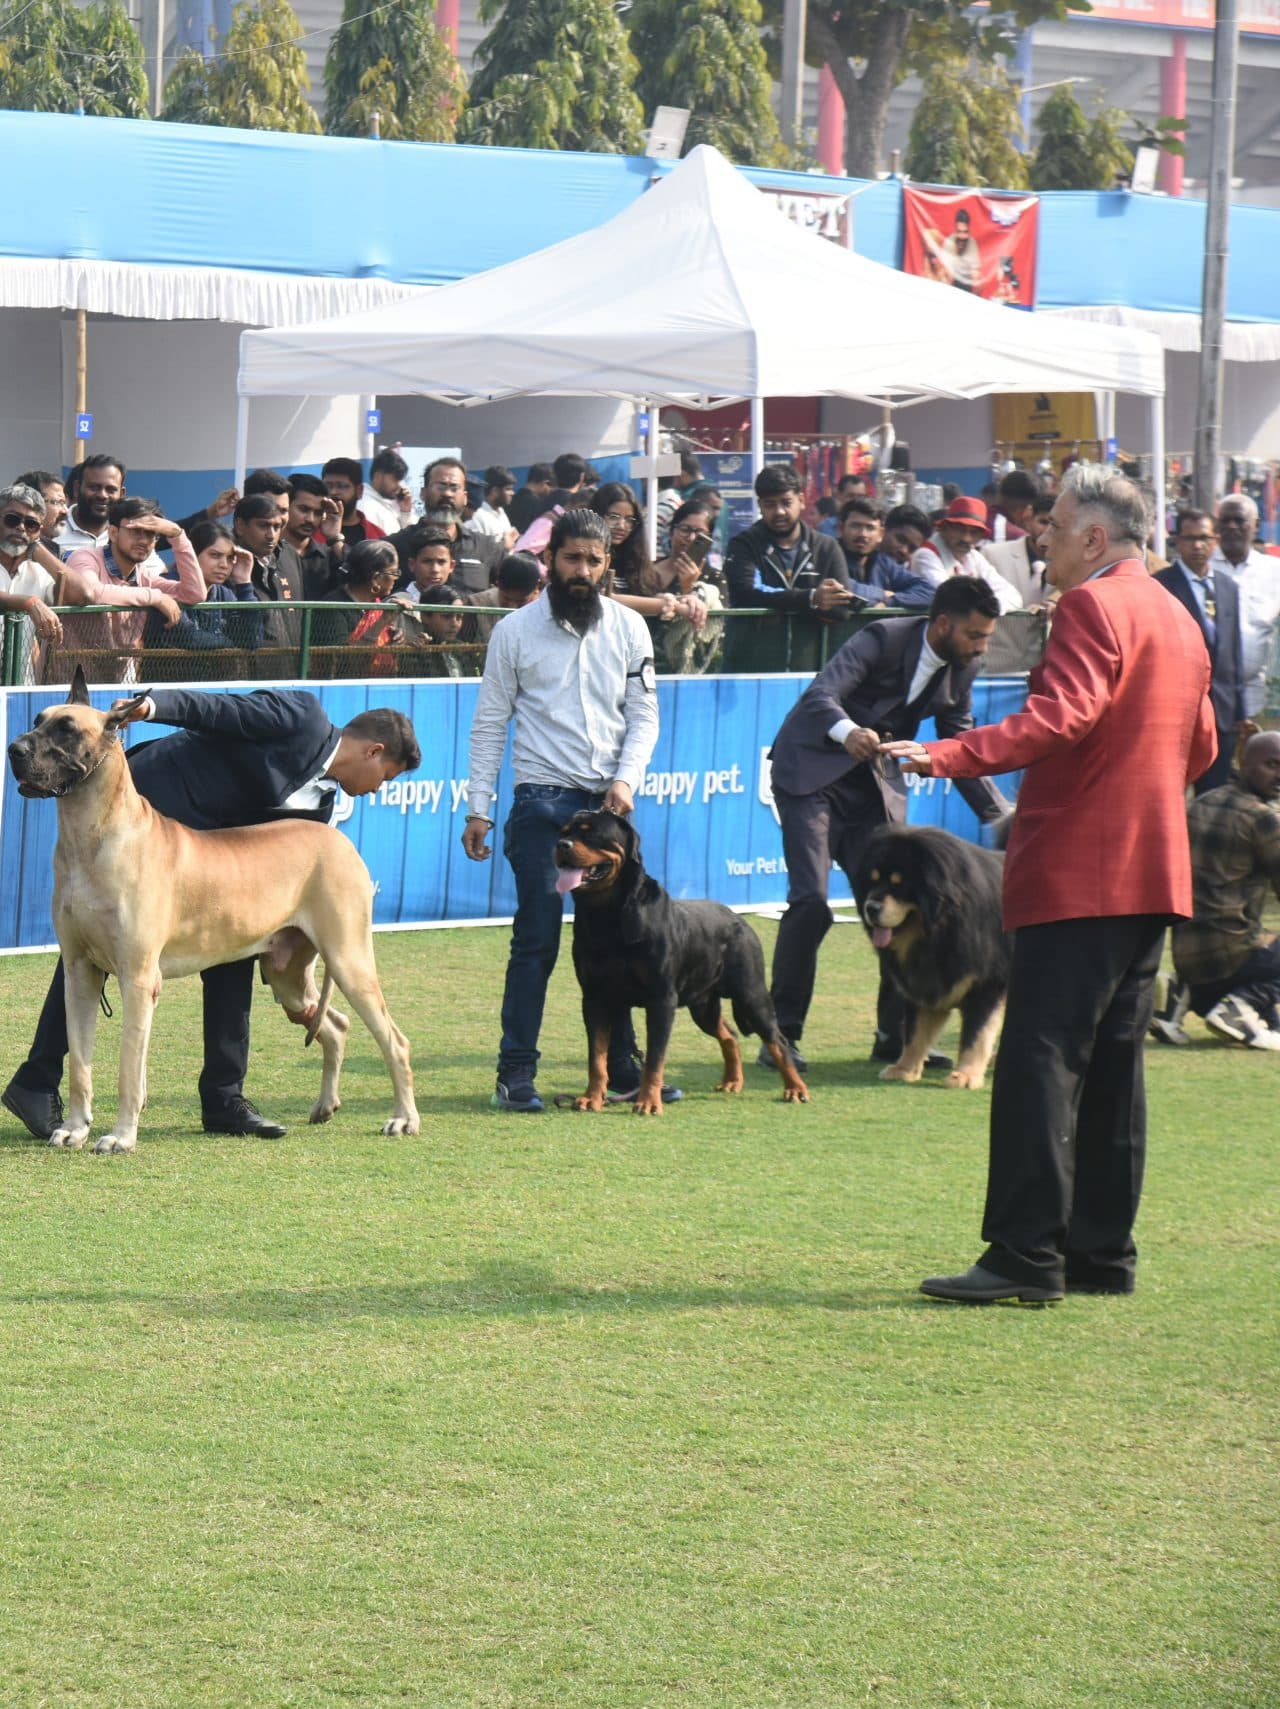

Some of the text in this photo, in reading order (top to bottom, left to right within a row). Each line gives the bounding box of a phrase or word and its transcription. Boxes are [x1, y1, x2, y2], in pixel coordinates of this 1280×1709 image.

[79, 420, 89, 432] S2
[703, 763, 745, 804] pet.
[726, 858, 754, 876] Your
[756, 856, 777, 874] Pet
